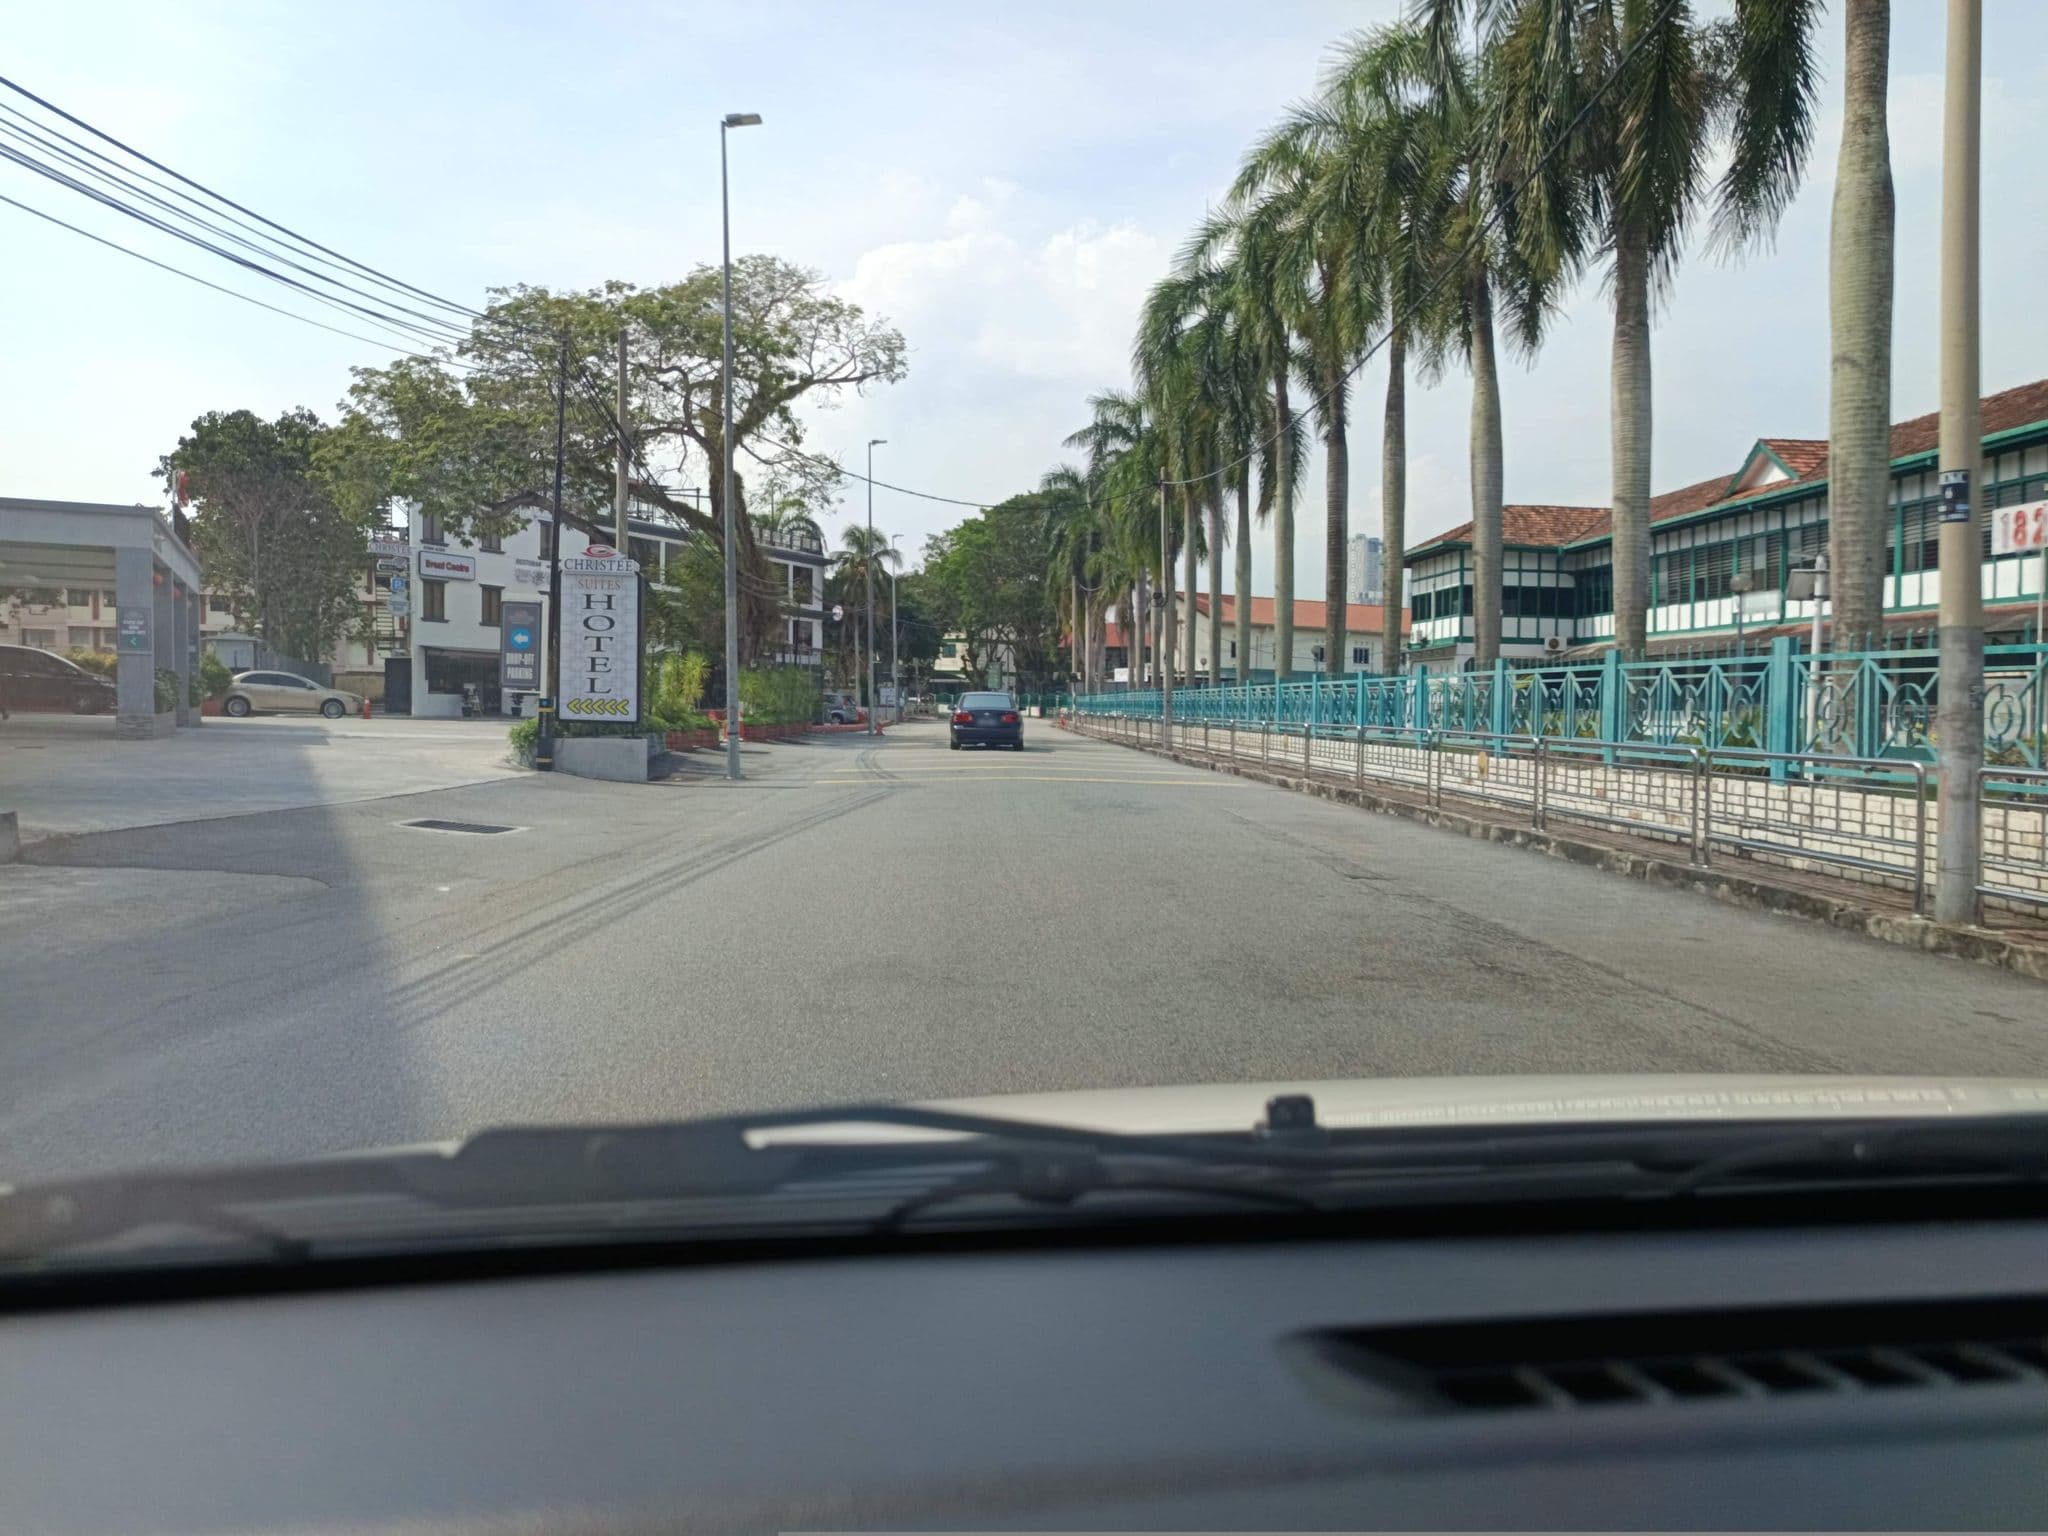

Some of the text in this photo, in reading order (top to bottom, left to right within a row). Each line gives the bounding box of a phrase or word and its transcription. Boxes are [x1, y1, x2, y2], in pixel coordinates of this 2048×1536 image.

[564, 558, 633, 572] CHRISTEE
[577, 578, 621, 591] SUITES
[583, 594, 616, 694] HOTEL
